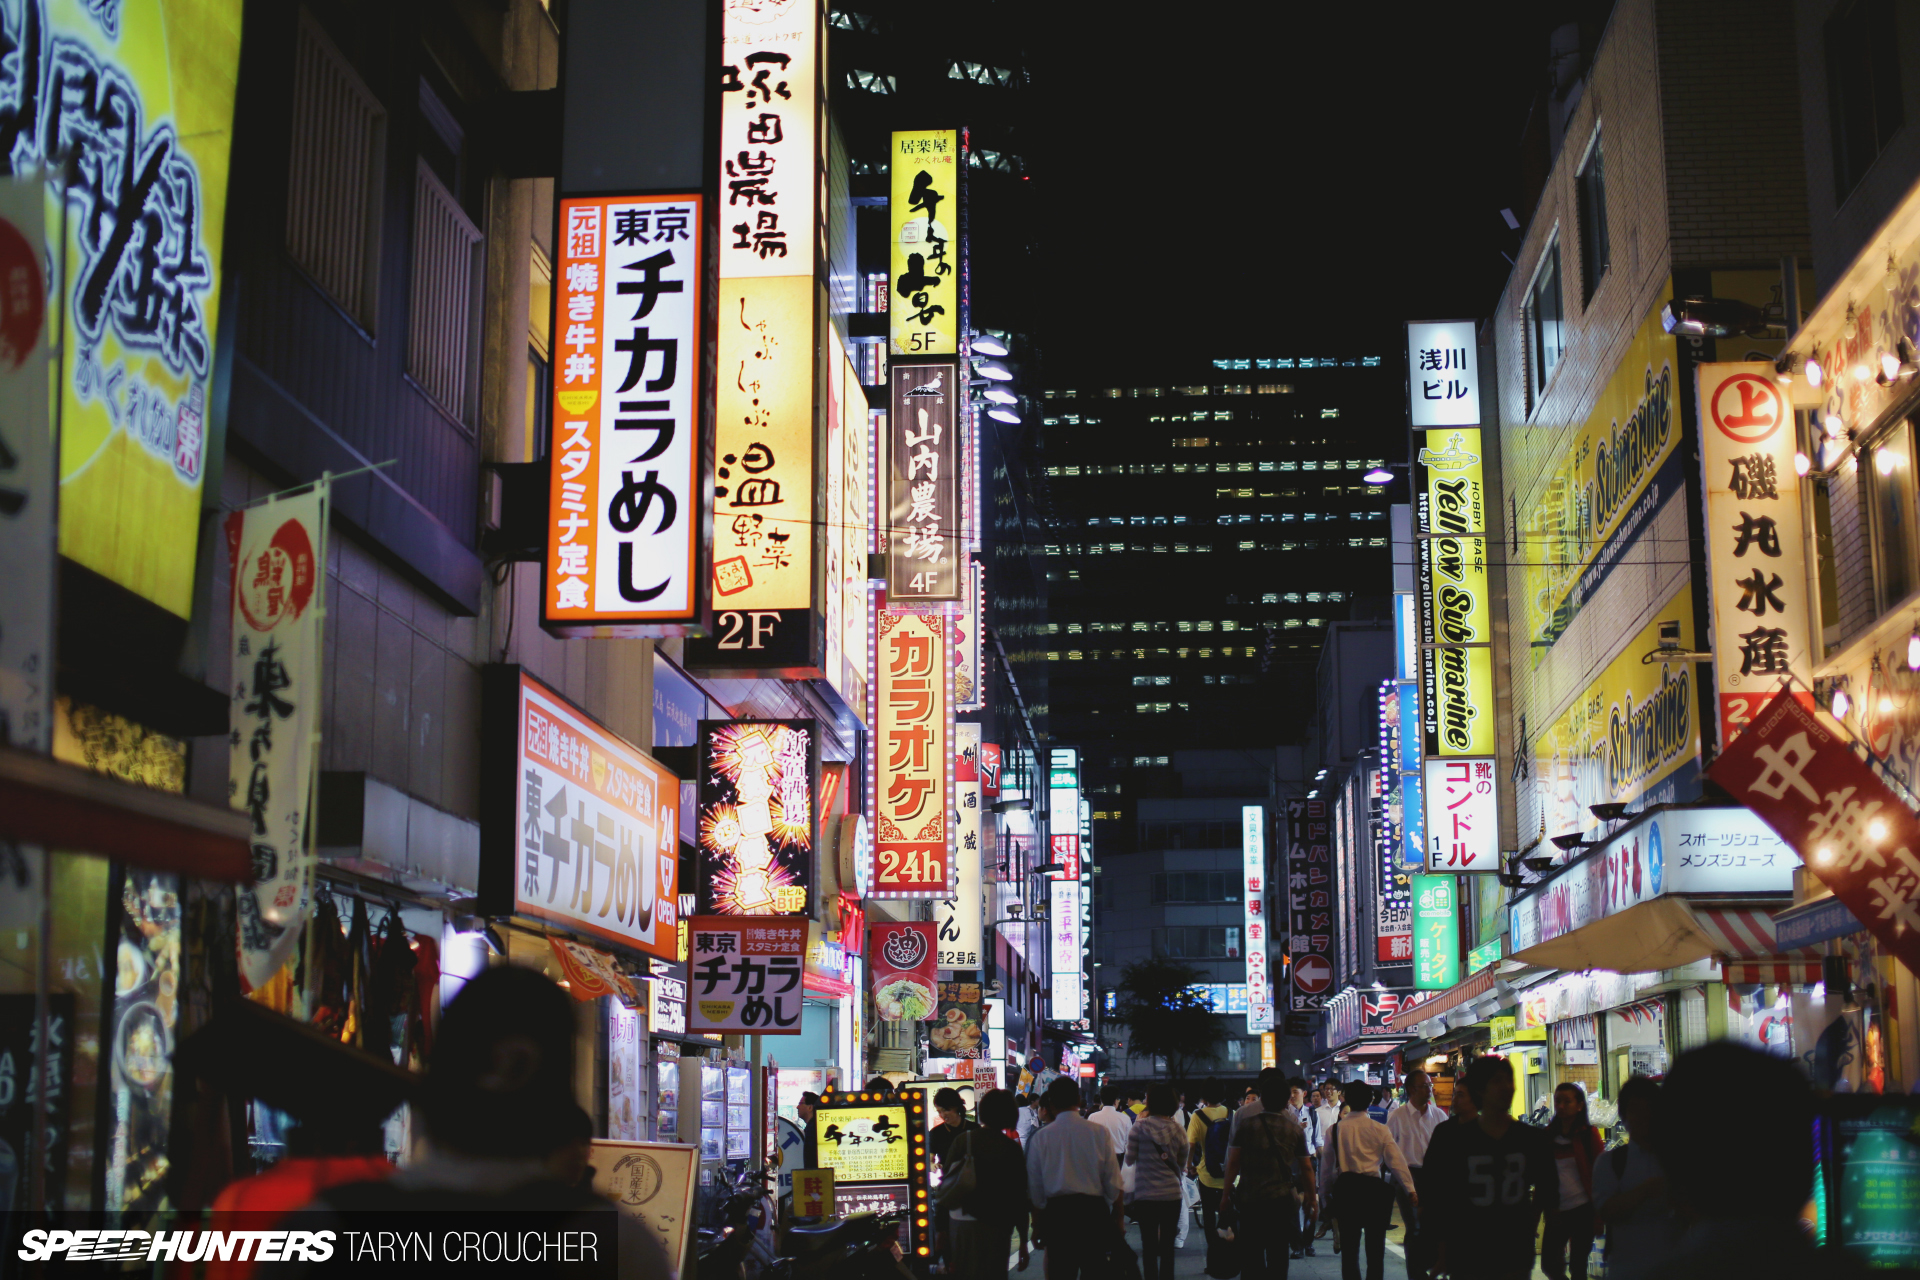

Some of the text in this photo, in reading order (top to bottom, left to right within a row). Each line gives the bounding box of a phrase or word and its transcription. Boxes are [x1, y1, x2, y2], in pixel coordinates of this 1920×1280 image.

[900, 139, 947, 154] 居楽屋
[914, 155, 952, 164] かくれ庵
[570, 207, 597, 257] 元祖
[612, 207, 690, 246] 東京
[564, 263, 598, 384] 焼き牛丼
[910, 332, 936, 351] 5F
[1420, 348, 1466, 371] 浅川
[1423, 379, 1468, 400] ビル
[608, 248, 684, 604] チカラめし
[903, 408, 944, 564] 山内農場
[556, 421, 592, 609] スタミナ定食
[714, 442, 791, 569] 温野菜
[1471, 482, 1484, 574] HOBBY BASE
[909, 572, 937, 593] 4F
[1728, 452, 1790, 677] 磯丸水産
[717, 612, 782, 649] 2F
[1434, 478, 1476, 751] Yellow Submarine
[888, 631, 936, 821] カラオケ
[549, 722, 589, 783] 焼き牛丼
[606, 762, 652, 818] スタミナ定食
[1475, 762, 1492, 795] 靴の
[524, 769, 543, 897] 東京
[661, 805, 674, 854] 24
[1446, 762, 1476, 867] コンドル
[543, 784, 654, 932] チカラめし
[878, 850, 943, 883] 24h
[1432, 836, 1443, 867] 1F
[1680, 853, 1776, 868] メンズシューズ
[1289, 801, 1310, 952] ゲーム・ホビー館
[1308, 801, 1330, 952] ヨドバシカメラ
[657, 897, 676, 927] OPEN
[777, 897, 804, 911] B1F
[1248, 877, 1262, 940] 世界堂
[1380, 909, 1412, 923] 今日か
[696, 933, 737, 954] 東京
[746, 942, 800, 953] スタミナ定食
[754, 928, 802, 941] 焼き牛丼
[1430, 922, 1447, 983] ケータイ
[694, 955, 801, 995] チカラ
[740, 995, 799, 1027] めし
[974, 1082, 997, 1090] OPEN
[975, 1073, 996, 1081] NEW
[818, 1113, 830, 1122] 5F
[824, 1115, 903, 1147] 千年の宴
[629, 1164, 645, 1202] 国産米
[841, 1172, 905, 1180] 03-5381-1288
[1467, 1152, 1526, 1207] 58
